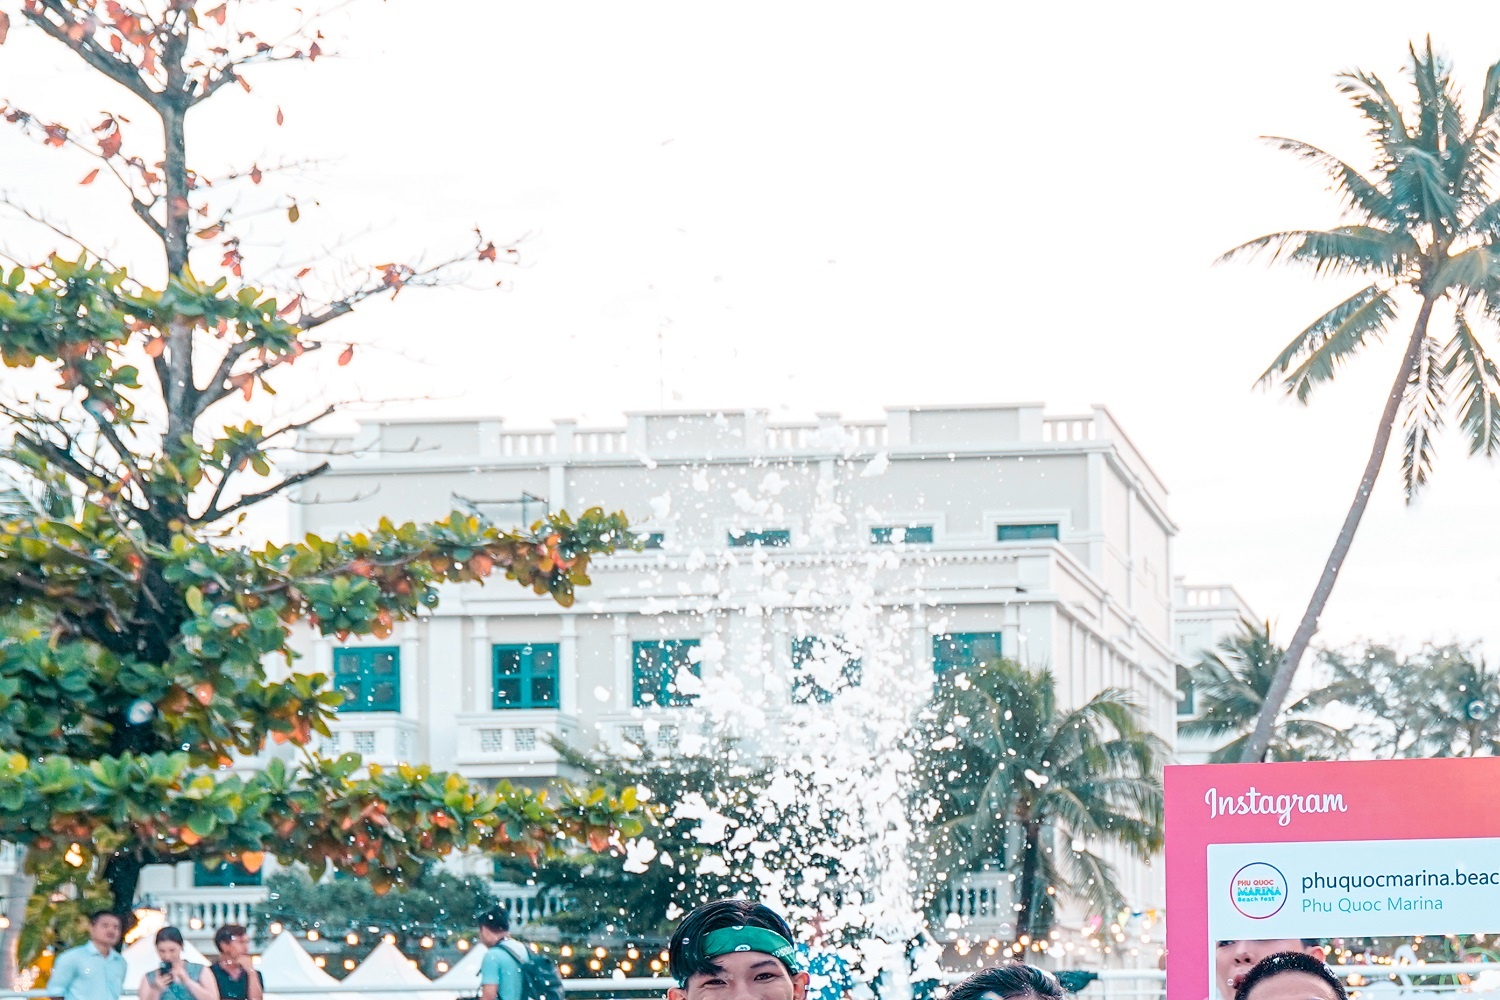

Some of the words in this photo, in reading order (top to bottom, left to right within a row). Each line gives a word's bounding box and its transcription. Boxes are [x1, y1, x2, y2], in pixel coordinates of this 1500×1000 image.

[1205, 787, 1347, 826] Instagram
[1237, 886, 1281, 896] MARINA
[1302, 897, 1333, 913] Phu
[1337, 897, 1382, 914] Quoc
[1387, 895, 1443, 911] Marina
